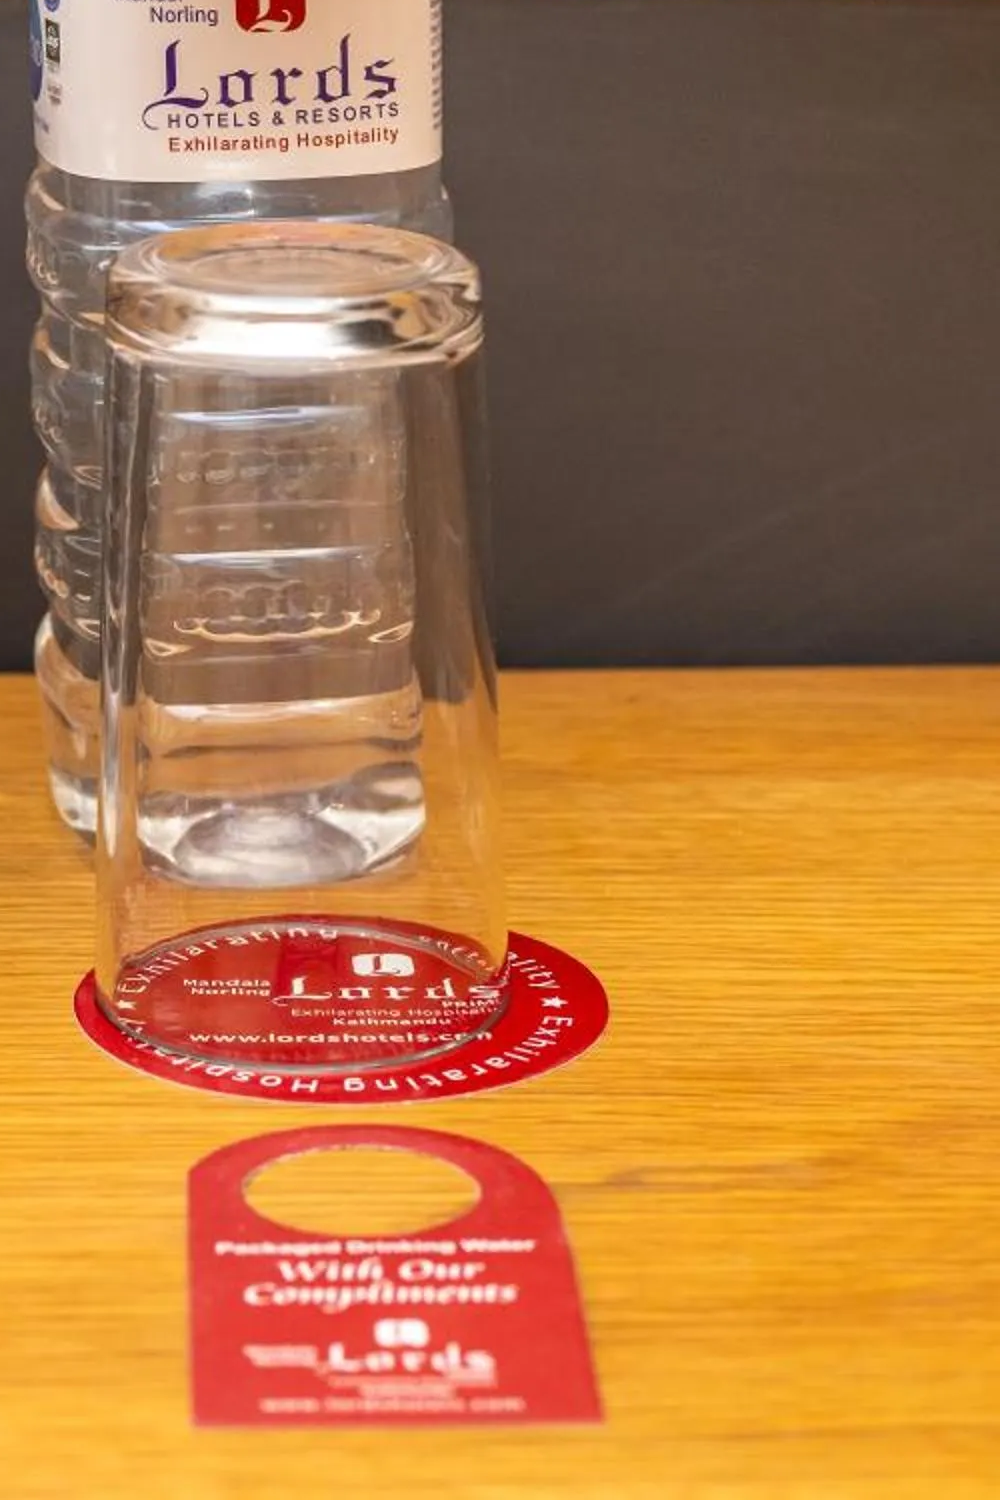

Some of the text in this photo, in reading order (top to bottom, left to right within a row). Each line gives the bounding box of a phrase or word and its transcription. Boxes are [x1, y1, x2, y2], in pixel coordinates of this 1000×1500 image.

[149, 6, 219, 26] Norling
[142, 32, 399, 131] Lords
[167, 102, 400, 130] HOTELS & RESORTS
[169, 126, 400, 155] Exhilarating Hospitality
[183, 978, 272, 988] Mandala
[191, 987, 272, 997] Norling
[271, 976, 501, 1007] Lords
[291, 1008, 402, 1019] Exhilarating
[332, 1017, 451, 1027] Kathmandu
[343, 1015, 573, 1092] Exhilarating
[278, 1256, 486, 1282] With Our
[244, 1279, 518, 1314] Compliments
[322, 1341, 496, 1375] Lords
